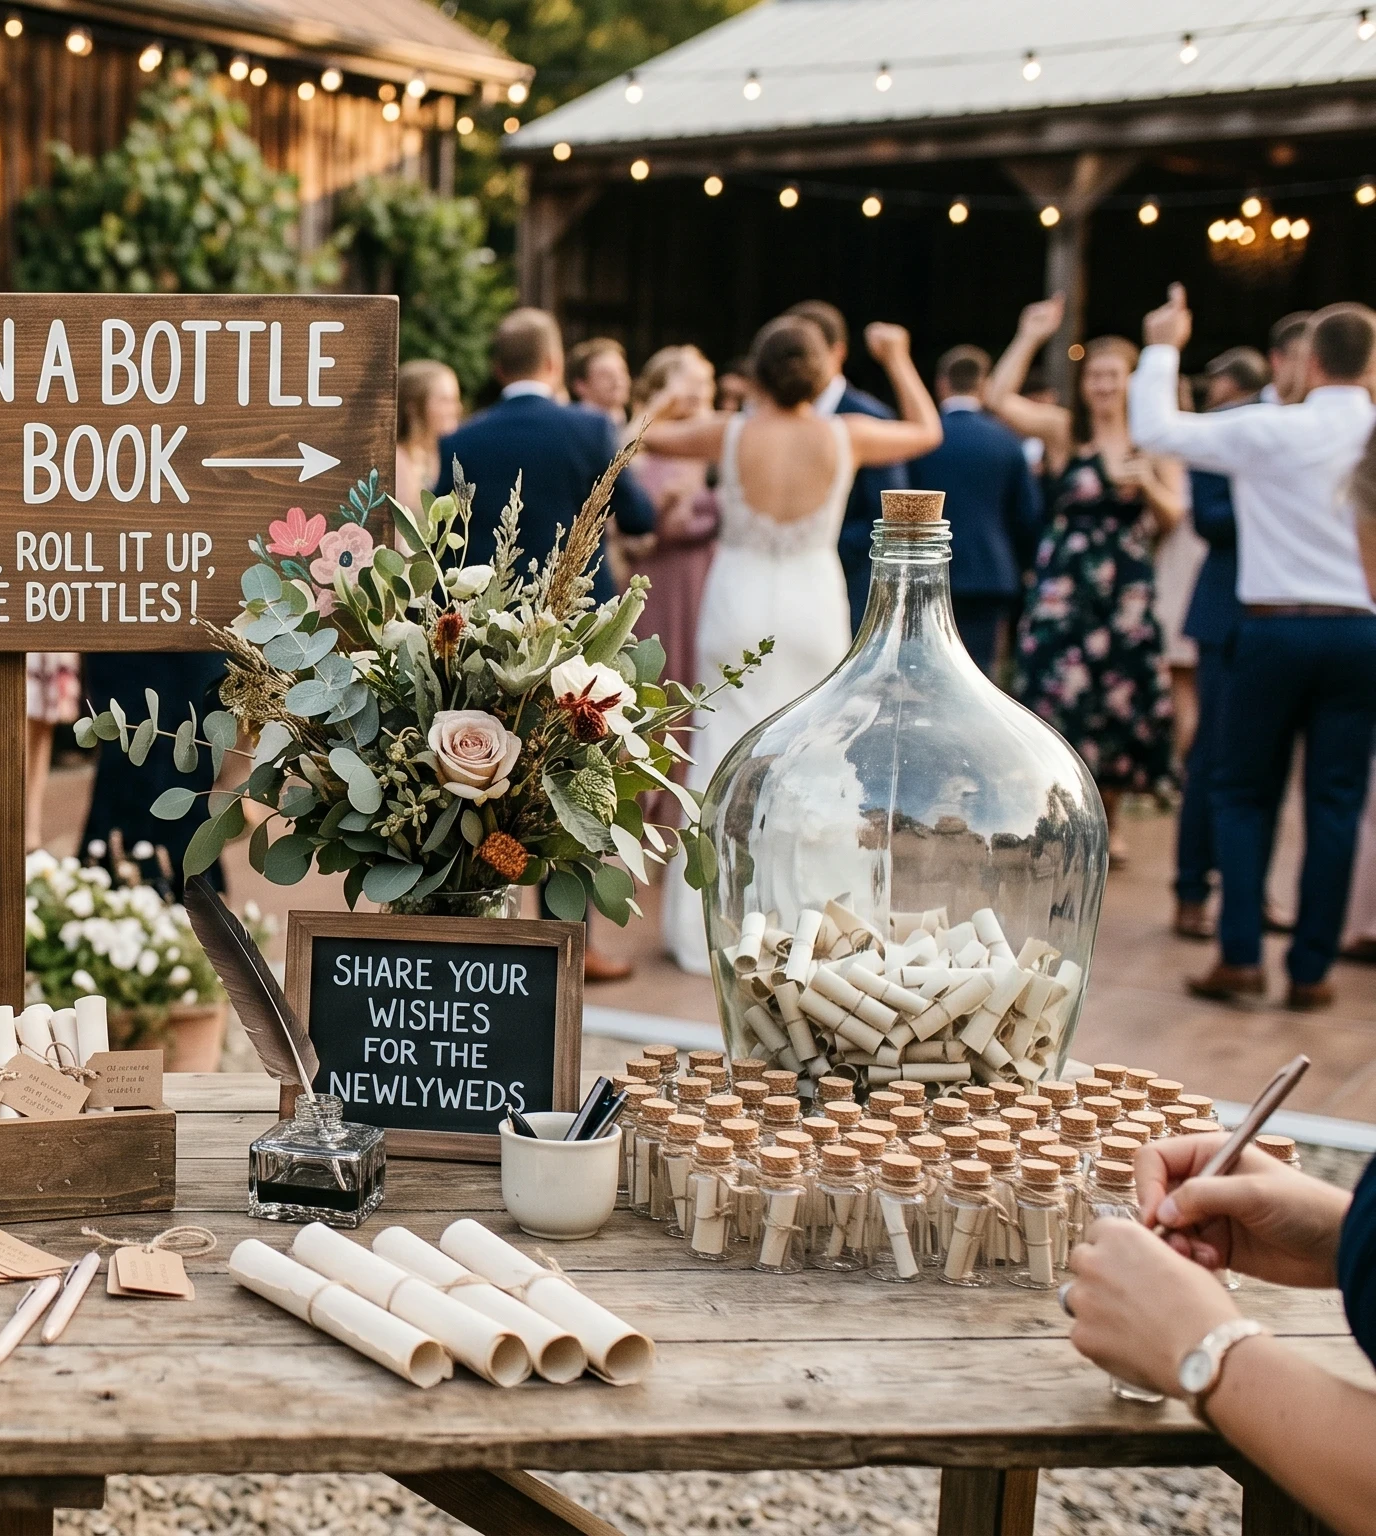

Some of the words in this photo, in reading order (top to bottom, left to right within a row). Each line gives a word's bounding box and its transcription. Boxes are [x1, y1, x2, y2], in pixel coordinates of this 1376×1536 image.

[35, 318, 79, 404] A
[101, 318, 345, 407] BOTTLE
[23, 422, 191, 505] BOOK
[16, 530, 105, 573] ROLL
[119, 531, 153, 573] IT
[166, 531, 216, 580] UP,
[25, 579, 199, 626] BOTTLES!
[332, 954, 434, 990] SHARE
[448, 960, 529, 996] YOUR
[368, 997, 491, 1035] WISHES
[364, 1037, 418, 1066] FOR
[429, 1041, 489, 1069] THE
[329, 1071, 526, 1113] NEWLYWEDS
